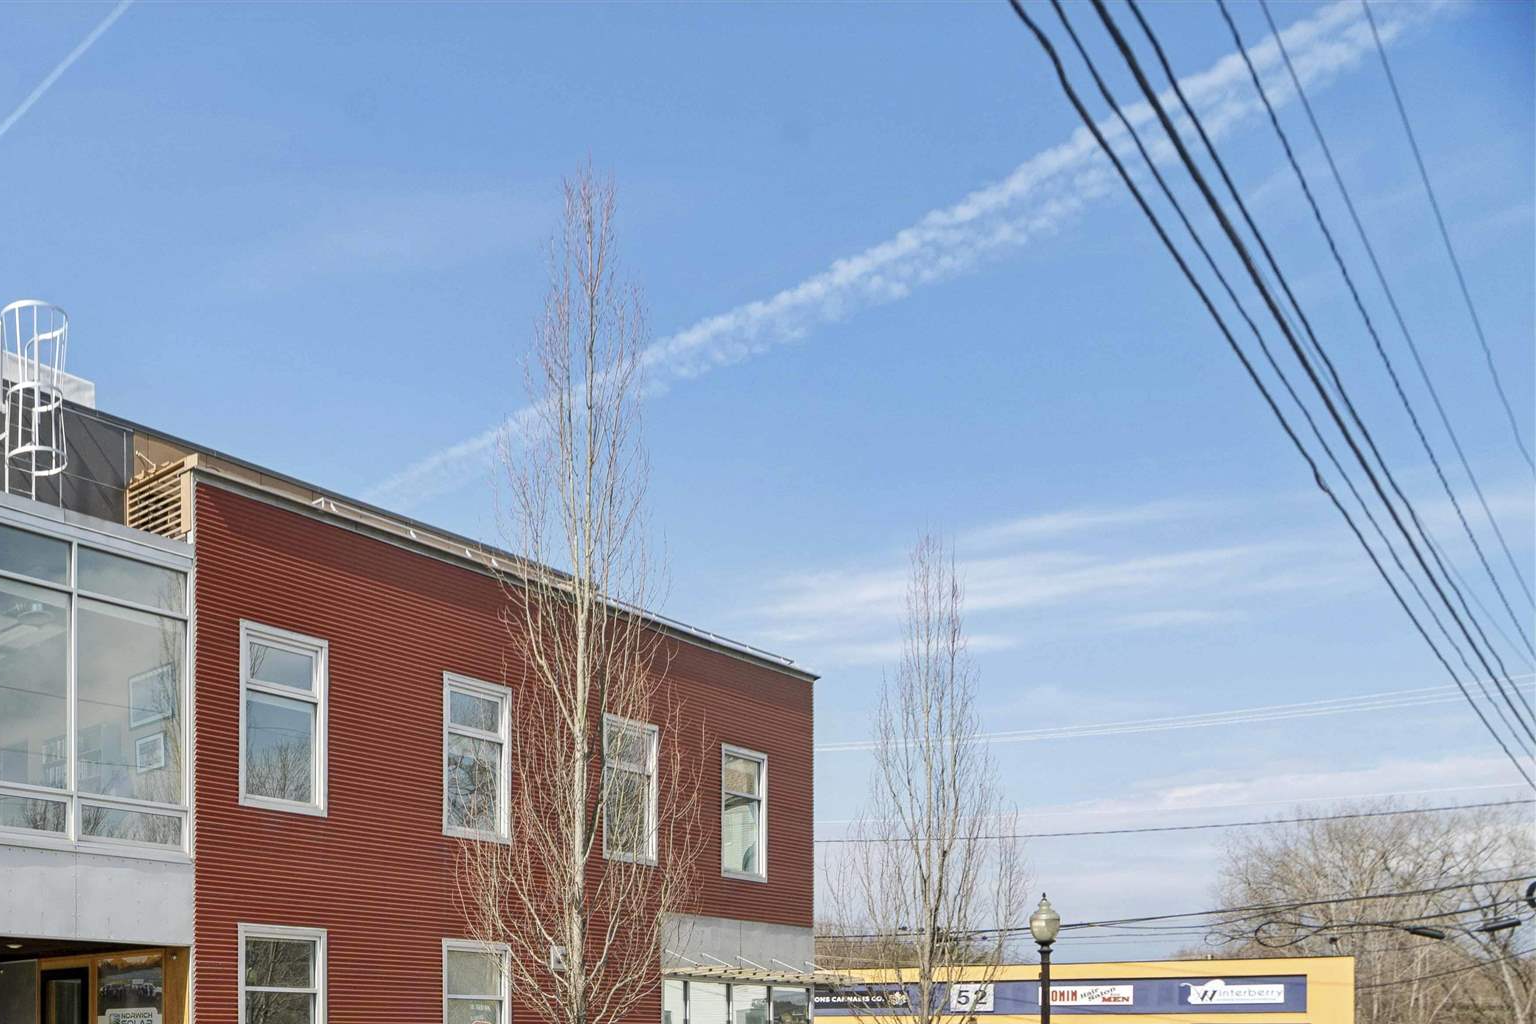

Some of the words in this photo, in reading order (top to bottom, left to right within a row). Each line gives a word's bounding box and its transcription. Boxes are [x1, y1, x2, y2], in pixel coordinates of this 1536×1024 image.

[957, 990, 988, 1006] 52
[1080, 988, 1100, 999] Hair
[1192, 988, 1283, 1002] Winterberry
